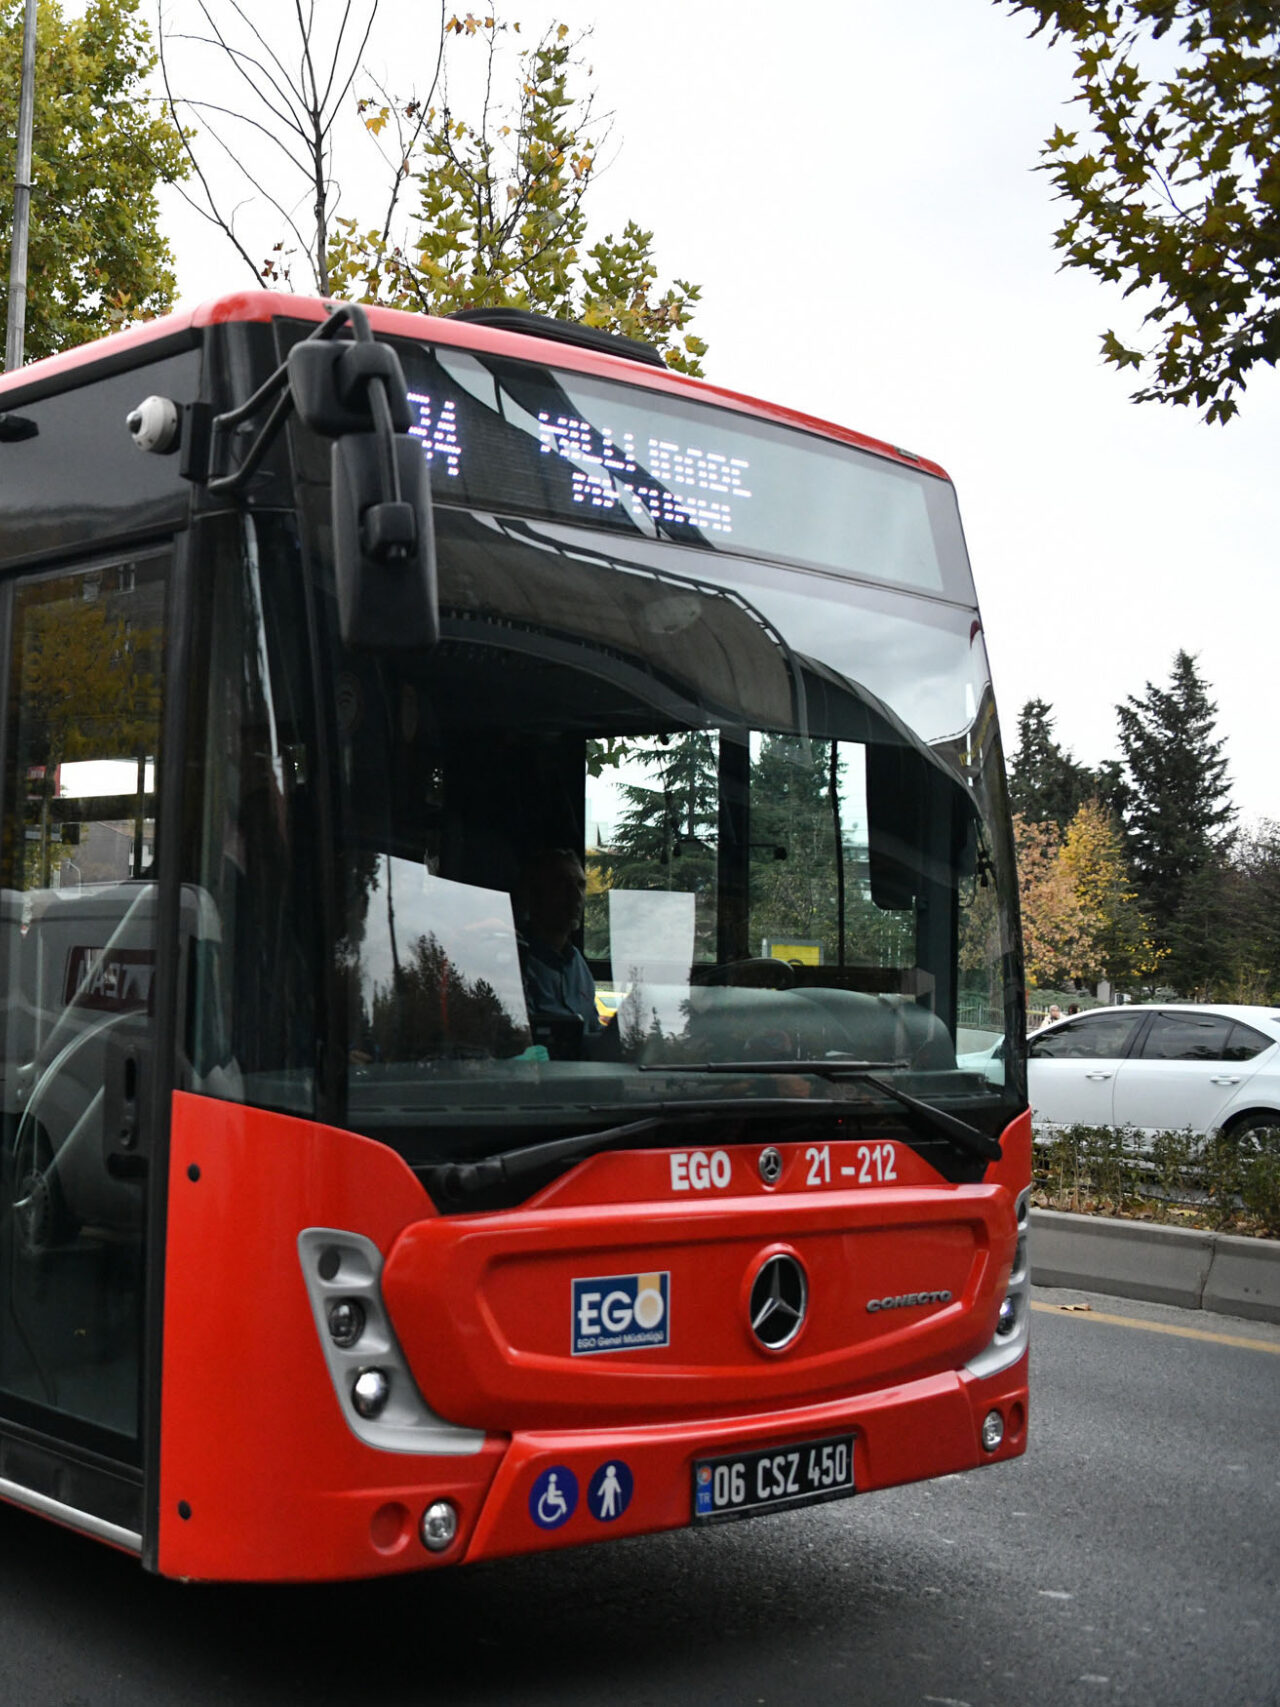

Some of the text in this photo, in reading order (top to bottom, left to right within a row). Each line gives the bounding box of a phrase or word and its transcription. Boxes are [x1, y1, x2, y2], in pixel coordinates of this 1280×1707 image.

[670, 1151, 731, 1191] EGO
[577, 1290, 664, 1336] EGO
[866, 1289, 952, 1312] CONECTO
[577, 1337, 596, 1349] EGO
[714, 1444, 847, 1506] 06 CSZ 450
[698, 1491, 711, 1506] TR
